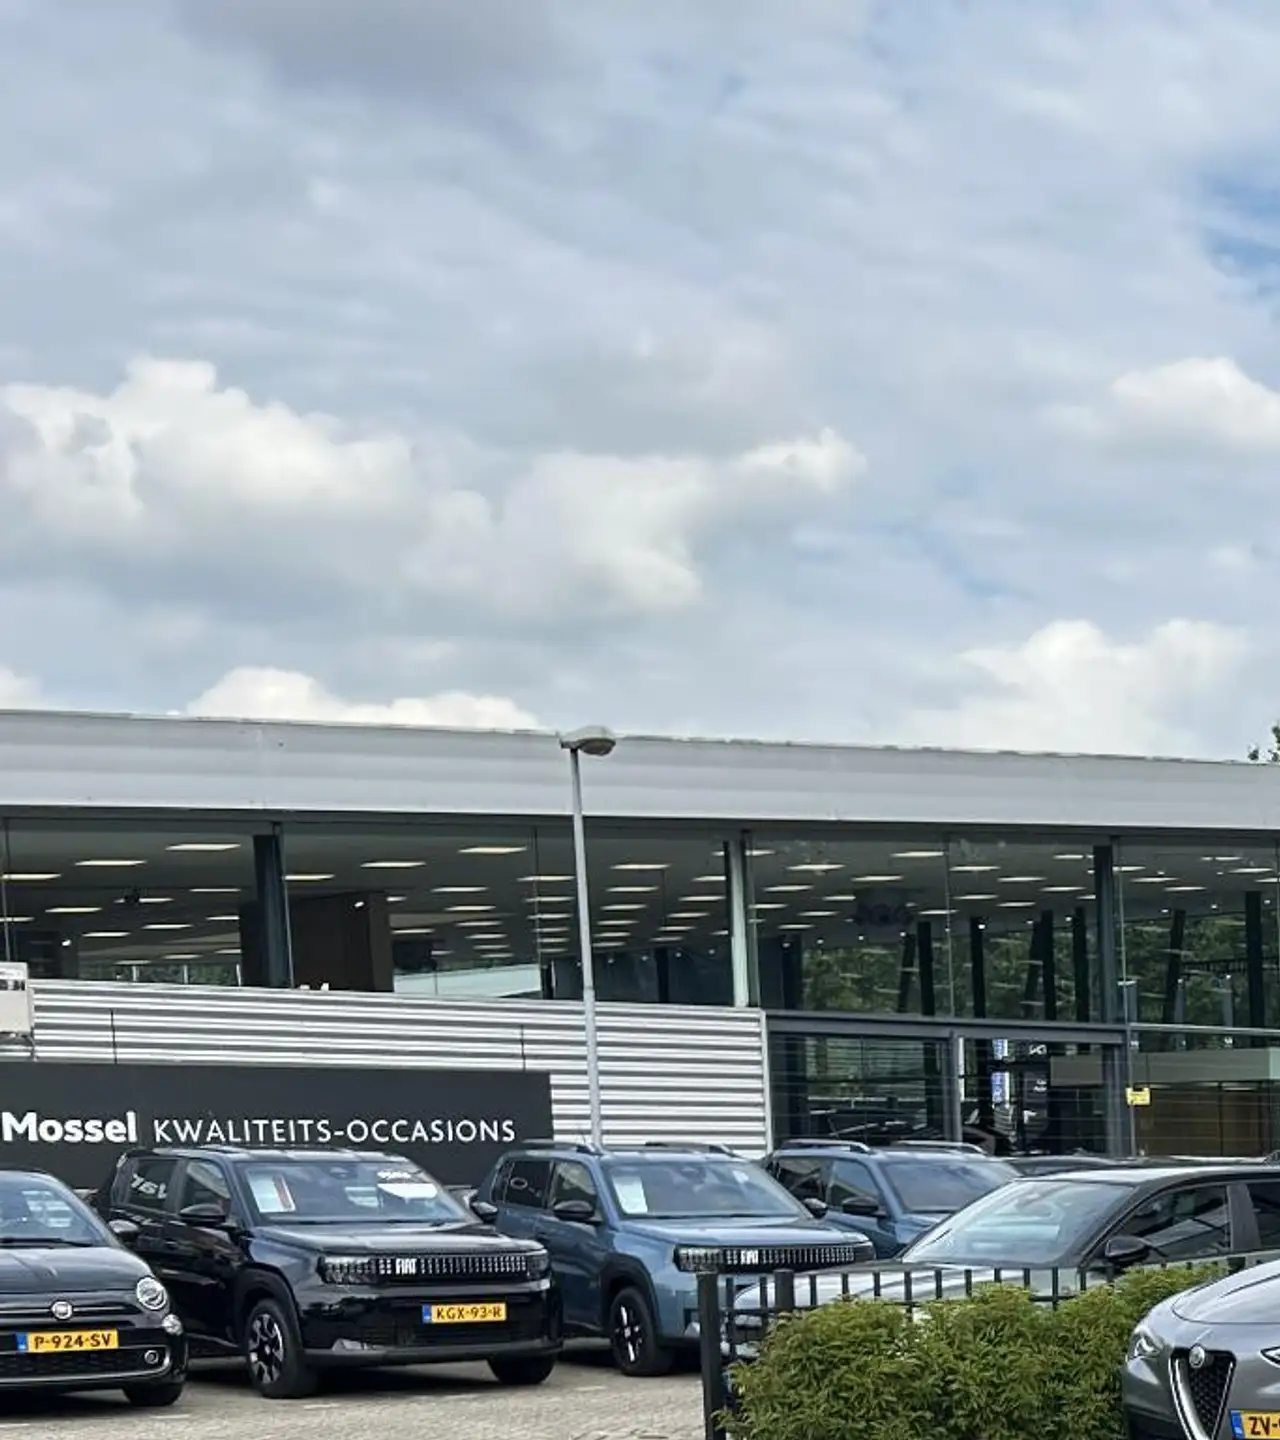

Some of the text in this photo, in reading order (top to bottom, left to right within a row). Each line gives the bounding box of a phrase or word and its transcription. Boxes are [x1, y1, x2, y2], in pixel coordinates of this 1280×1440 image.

[1, 1111, 516, 1143] Mossel KWALITEITS-OCCASIONS
[34, 1333, 112, 1349] P-924-SV
